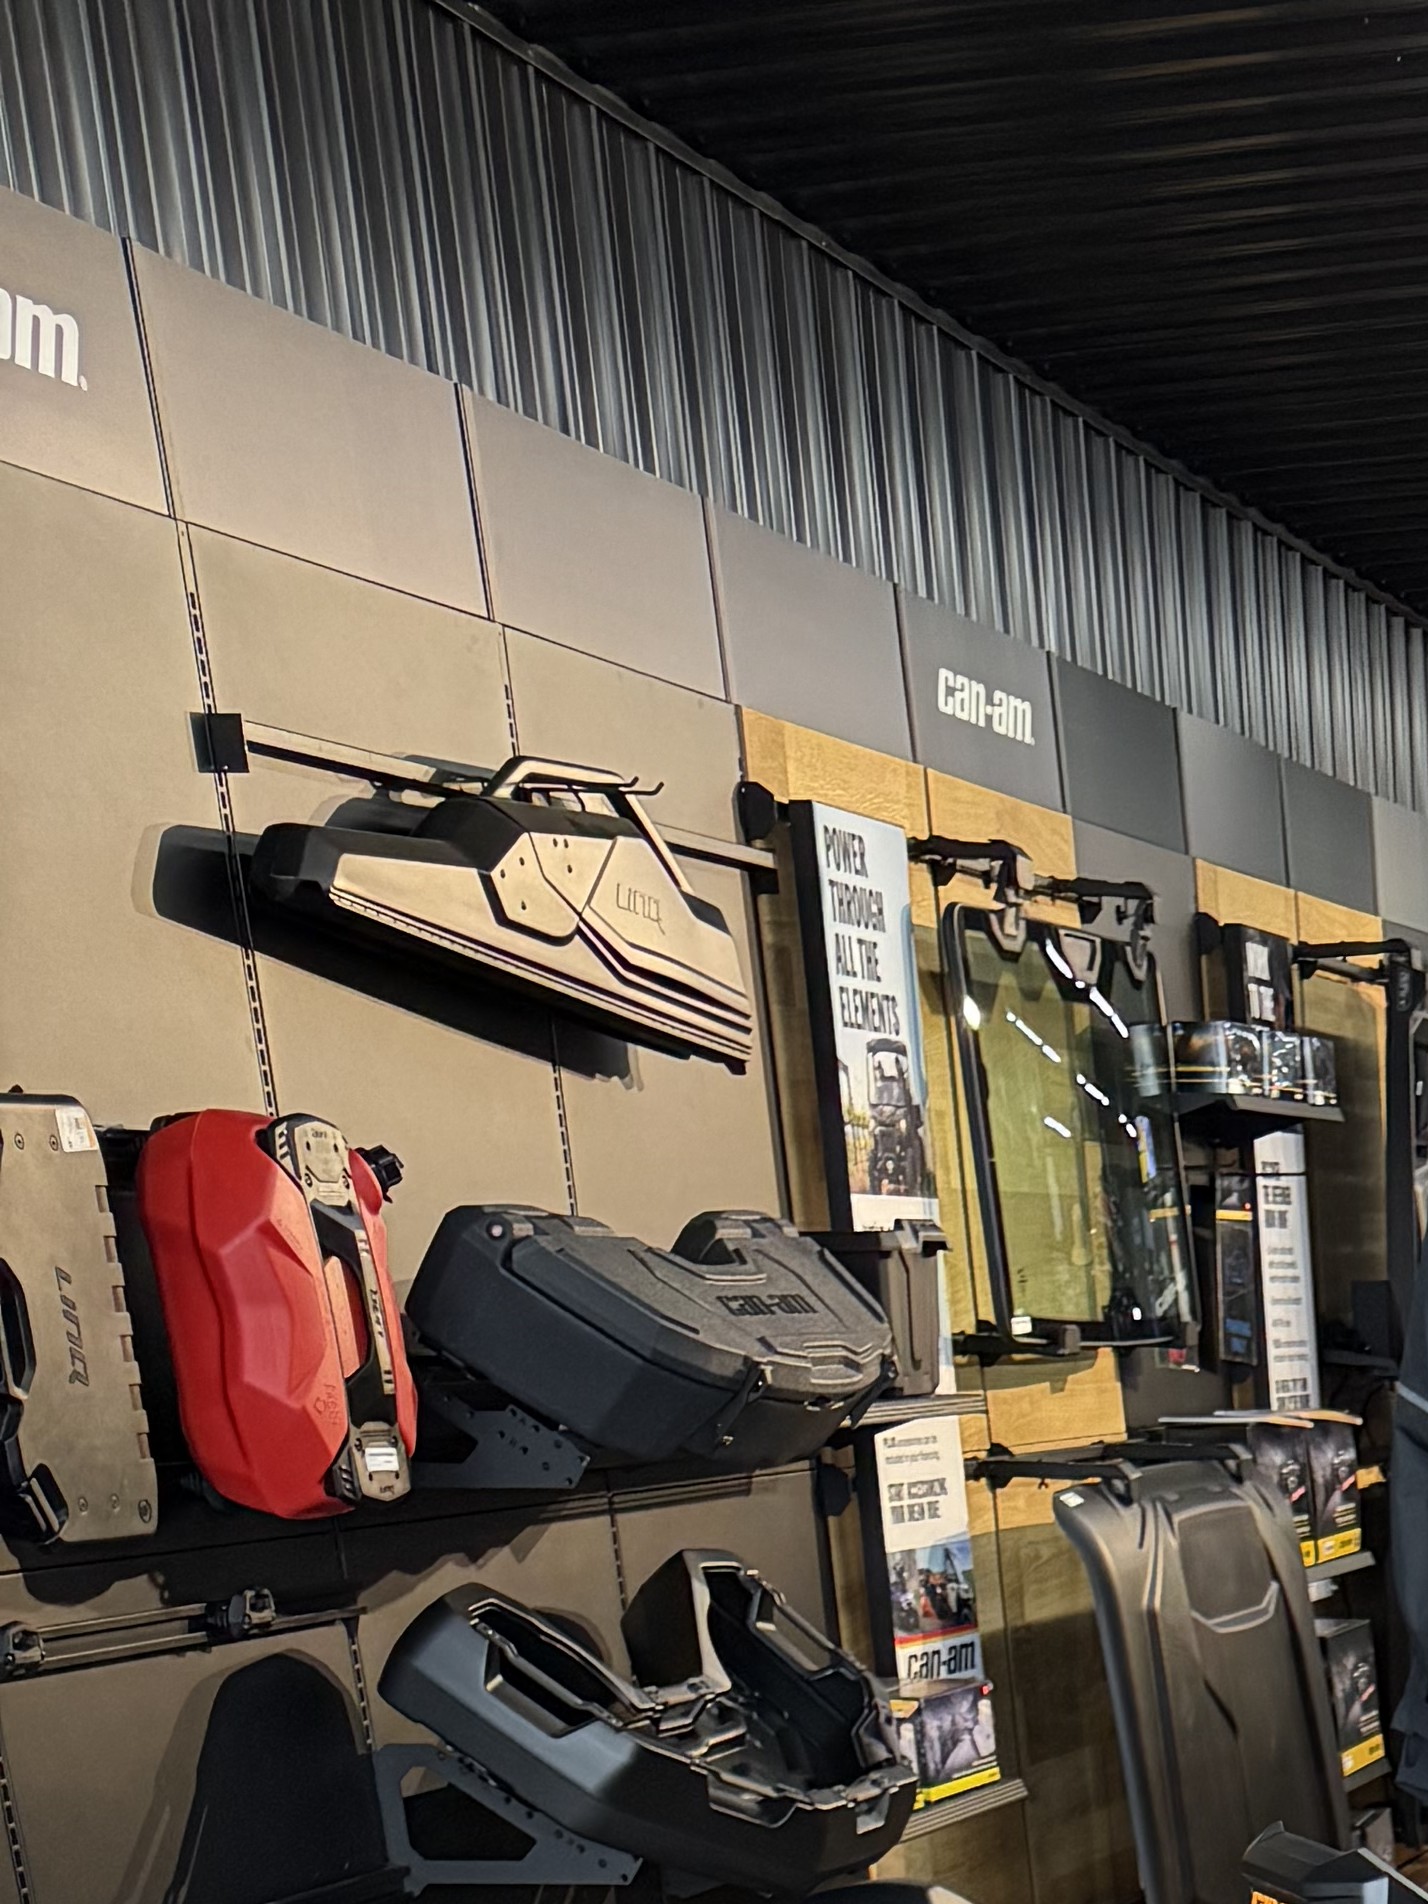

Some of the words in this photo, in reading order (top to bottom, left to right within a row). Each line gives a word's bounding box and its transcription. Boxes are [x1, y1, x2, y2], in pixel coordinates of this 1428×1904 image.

[936, 666, 1034, 745] can-am
[822, 825, 869, 878] POWER
[828, 879, 887, 933] THROUGH
[835, 932, 858, 978] ALL
[857, 938, 882, 982] THE
[839, 985, 901, 1036] ELEMENTS
[716, 1289, 815, 1320] can-am
[906, 1638, 976, 1681] can-am
